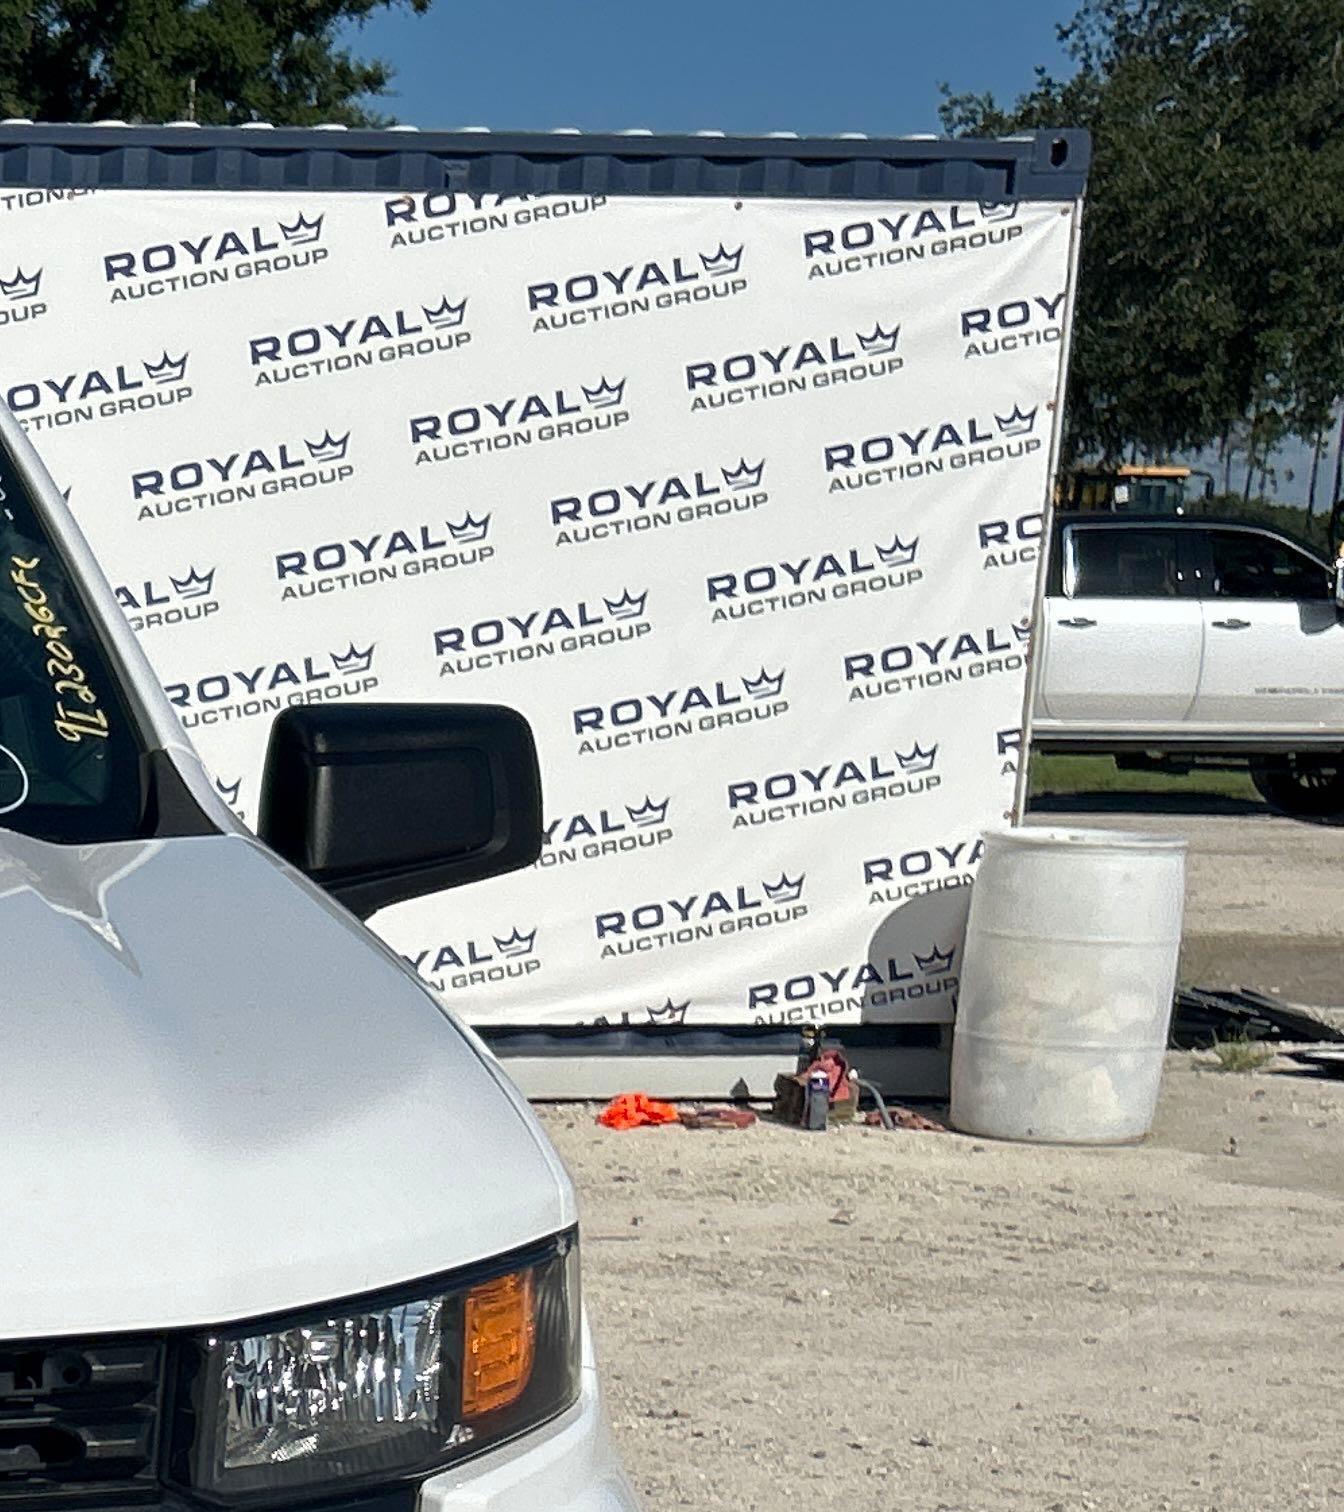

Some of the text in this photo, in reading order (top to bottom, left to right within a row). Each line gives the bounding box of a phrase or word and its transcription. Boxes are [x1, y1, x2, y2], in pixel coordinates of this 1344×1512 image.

[391, 196, 606, 248] AUCTION GROUP
[803, 205, 976, 258] ROYAL
[103, 226, 280, 281] ROYAL
[110, 248, 328, 303] AUCTION GROUP
[808, 226, 1023, 279] AUCTION GROUP
[527, 257, 700, 311] ROYAL
[533, 279, 747, 332] AUCTION GROUP
[249, 310, 423, 365] ROYAL
[255, 332, 471, 387] AUCTION GROUP
[685, 337, 857, 390] ROYAL
[99, 389, 193, 419] GROUP
[691, 358, 903, 412] AUCTION GROUP
[410, 390, 582, 444] ROYAL
[415, 411, 629, 465] AUCTION GROUP
[132, 444, 306, 499] ROYAL
[824, 419, 994, 472] ROYAL
[828, 439, 1040, 493] AUCTION GROUP
[138, 465, 354, 521] AUCTION GROUP
[550, 472, 721, 525] ROYAL
[556, 493, 768, 546] AUCTION GROUP
[275, 525, 447, 580] ROYAL
[281, 546, 494, 601] AUCTION GROUP
[706, 549, 876, 602] ROYAL
[711, 569, 922, 623] AUCTION GROUP
[434, 602, 604, 656] ROYAL
[439, 623, 651, 677] AUCTION GROUP
[844, 628, 1012, 681] ROYAL
[573, 681, 742, 734] ROYAL
[849, 666, 963, 701] AUCTION
[578, 701, 788, 755] AUCTION GROUP
[728, 756, 895, 808] ROYAL
[732, 775, 941, 829] AUCTION GROUP
[582, 829, 672, 858] GROUP
[595, 886, 762, 939] ROYAL
[600, 905, 808, 959] AUCTION GROUP
[749, 961, 914, 1010] ROYAL
[867, 980, 958, 1009] GROUP
